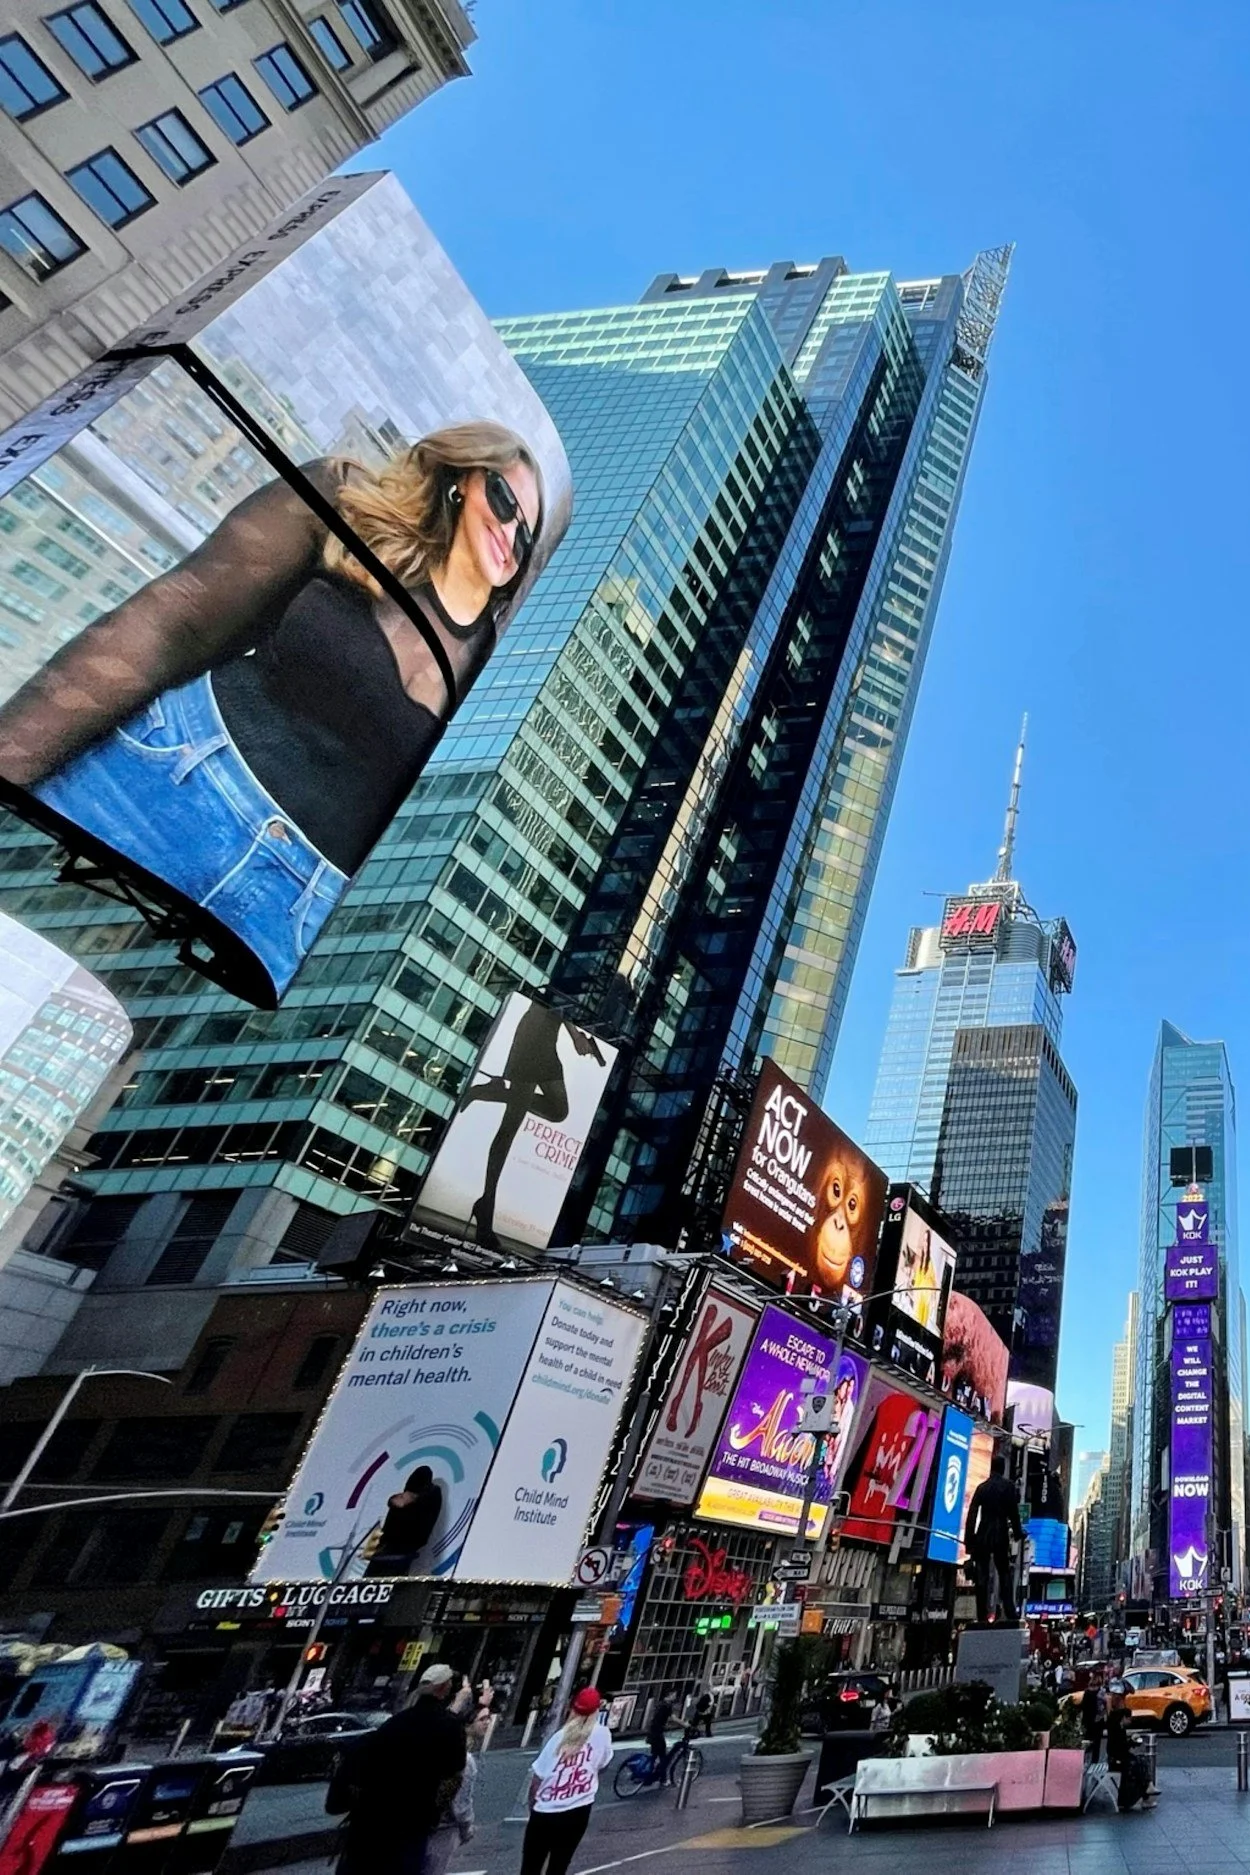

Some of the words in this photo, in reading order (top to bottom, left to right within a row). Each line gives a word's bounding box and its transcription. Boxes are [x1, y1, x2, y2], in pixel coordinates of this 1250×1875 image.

[267, 190, 342, 241] EXPRESS
[175, 249, 267, 316] EXPRESS
[943, 902, 1000, 936] H&M
[764, 1084, 808, 1137] ACT
[523, 1118, 583, 1153] PERFECT
[757, 1112, 813, 1179] NOW
[535, 1142, 578, 1171] CRIME
[752, 1145, 768, 1168] for
[767, 1158, 817, 1209] Orangutans
[889, 1213, 902, 1222] LG
[421, 1226, 444, 1241] Theater
[1182, 1231, 1203, 1240] KOK
[1180, 1256, 1203, 1265] JUST
[1170, 1268, 1189, 1277] KOK
[1189, 1267, 1213, 1277] PLAY
[381, 1300, 427, 1318] Right
[429, 1299, 468, 1314] now,
[559, 1300, 571, 1312] You
[573, 1307, 587, 1318] can
[370, 1321, 430, 1339] there's
[433, 1324, 444, 1335] a
[449, 1318, 497, 1335] crisis
[551, 1316, 579, 1335] Donate
[579, 1327, 600, 1345] today
[600, 1337, 615, 1348] and
[359, 1347, 375, 1363] in
[379, 1345, 464, 1361] children's
[545, 1337, 576, 1354] support
[576, 1345, 589, 1359] the
[589, 1353, 614, 1368] mental
[760, 1338, 769, 1353] A
[769, 1341, 798, 1367] WHOLE
[786, 1334, 816, 1360] ESCAPE
[816, 1348, 826, 1365] TO
[538, 1352, 563, 1370] health
[564, 1363, 574, 1373] of
[573, 1367, 579, 1375] a
[579, 1368, 598, 1381] child
[598, 1375, 605, 1383] in
[605, 1378, 623, 1390] need
[1183, 1357, 1201, 1365] WILL
[348, 1368, 409, 1388] mental
[413, 1366, 473, 1385] health.
[1177, 1368, 1208, 1376] CHANGE
[1185, 1380, 1200, 1388] THE
[1178, 1392, 1207, 1400] DIGITAL
[1175, 1404, 1210, 1413] CONTENT
[1176, 1416, 1208, 1425] MARKET
[723, 1451, 736, 1467] THE
[737, 1456, 751, 1470] HIT
[750, 1460, 788, 1480] BROADWAY
[787, 1471, 810, 1486] MUSIC
[1174, 1475, 1209, 1483] DOWNLOAD
[514, 1486, 541, 1506] Child
[543, 1491, 569, 1509] Mind
[1173, 1483, 1209, 1498] NOW
[285, 1519, 306, 1529] Child
[307, 1519, 328, 1528] Mind
[514, 1506, 558, 1526] Institute
[285, 1529, 318, 1538] Institute
[1179, 1579, 1203, 1591] KOK
[196, 1588, 268, 1608] GIFTS
[287, 1619, 315, 1628] SONY
[540, 1773, 595, 1803] Grand
[555, 1766, 588, 1790] Life
